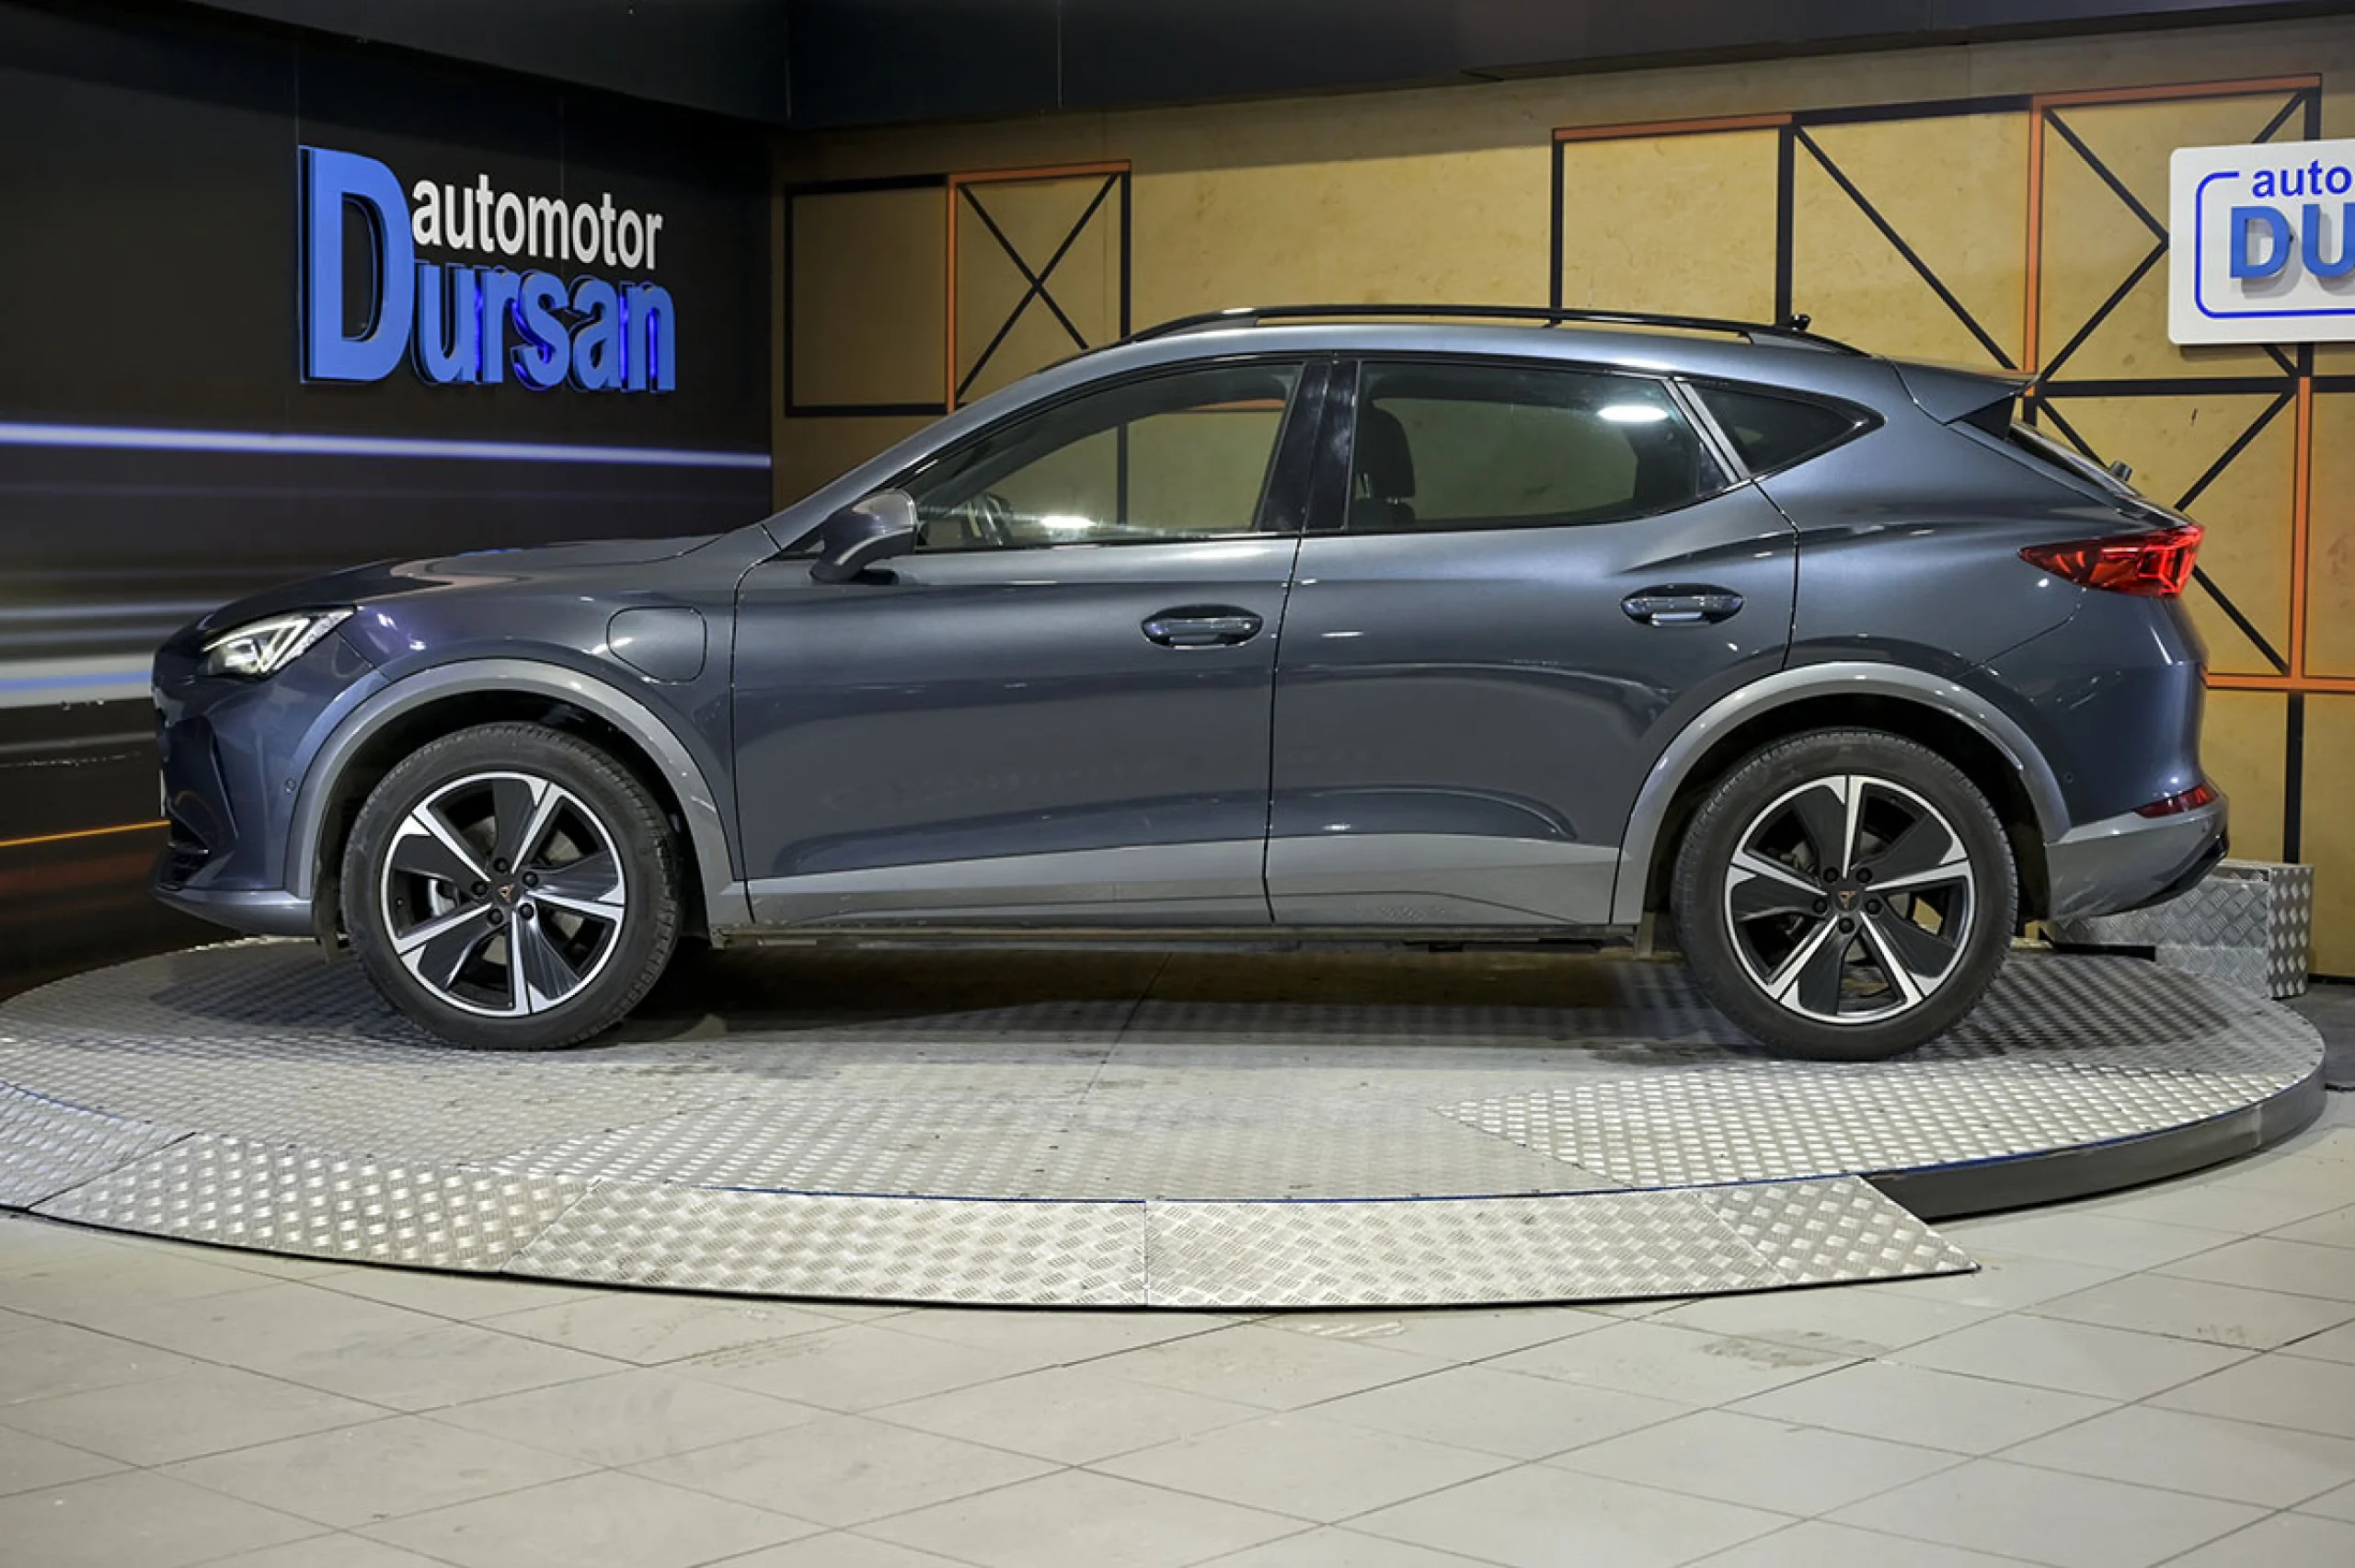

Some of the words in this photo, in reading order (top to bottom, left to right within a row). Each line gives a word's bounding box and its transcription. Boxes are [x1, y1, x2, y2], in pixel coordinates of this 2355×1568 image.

[411, 173, 663, 269] automotor
[2252, 159, 2352, 198] auto
[298, 145, 676, 394] Dursan
[2230, 202, 2355, 280] DU
